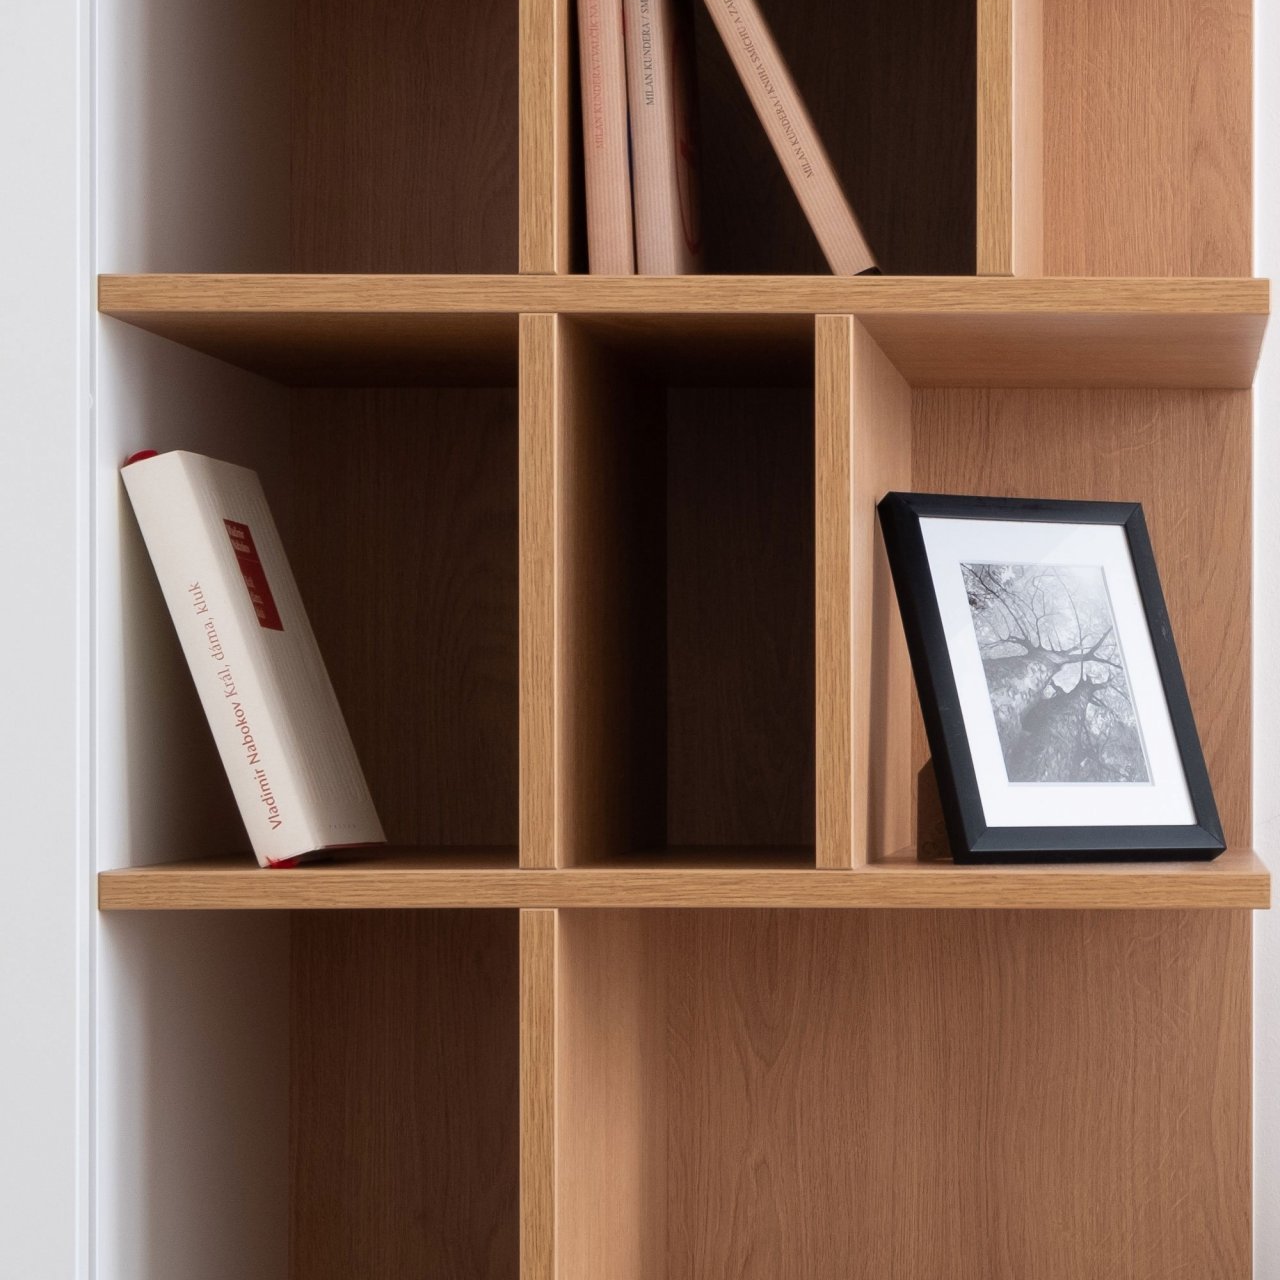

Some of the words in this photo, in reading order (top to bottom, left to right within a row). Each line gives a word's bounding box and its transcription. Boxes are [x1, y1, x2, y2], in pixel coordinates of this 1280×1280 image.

[732, 15, 742, 25] A
[641, 21, 652, 70] KUNDERA
[734, 24, 760, 64] SMÍCHU
[644, 72, 654, 105] MILAN
[754, 62, 775, 95] KNIHA
[773, 99, 798, 146] KUNDERA
[793, 145, 814, 178] MILAN
[188, 581, 208, 615] kluk
[203, 616, 226, 662] dáma,
[216, 663, 239, 699] Král,
[231, 700, 261, 766] Nabokov
[253, 766, 283, 830] Vladimir
